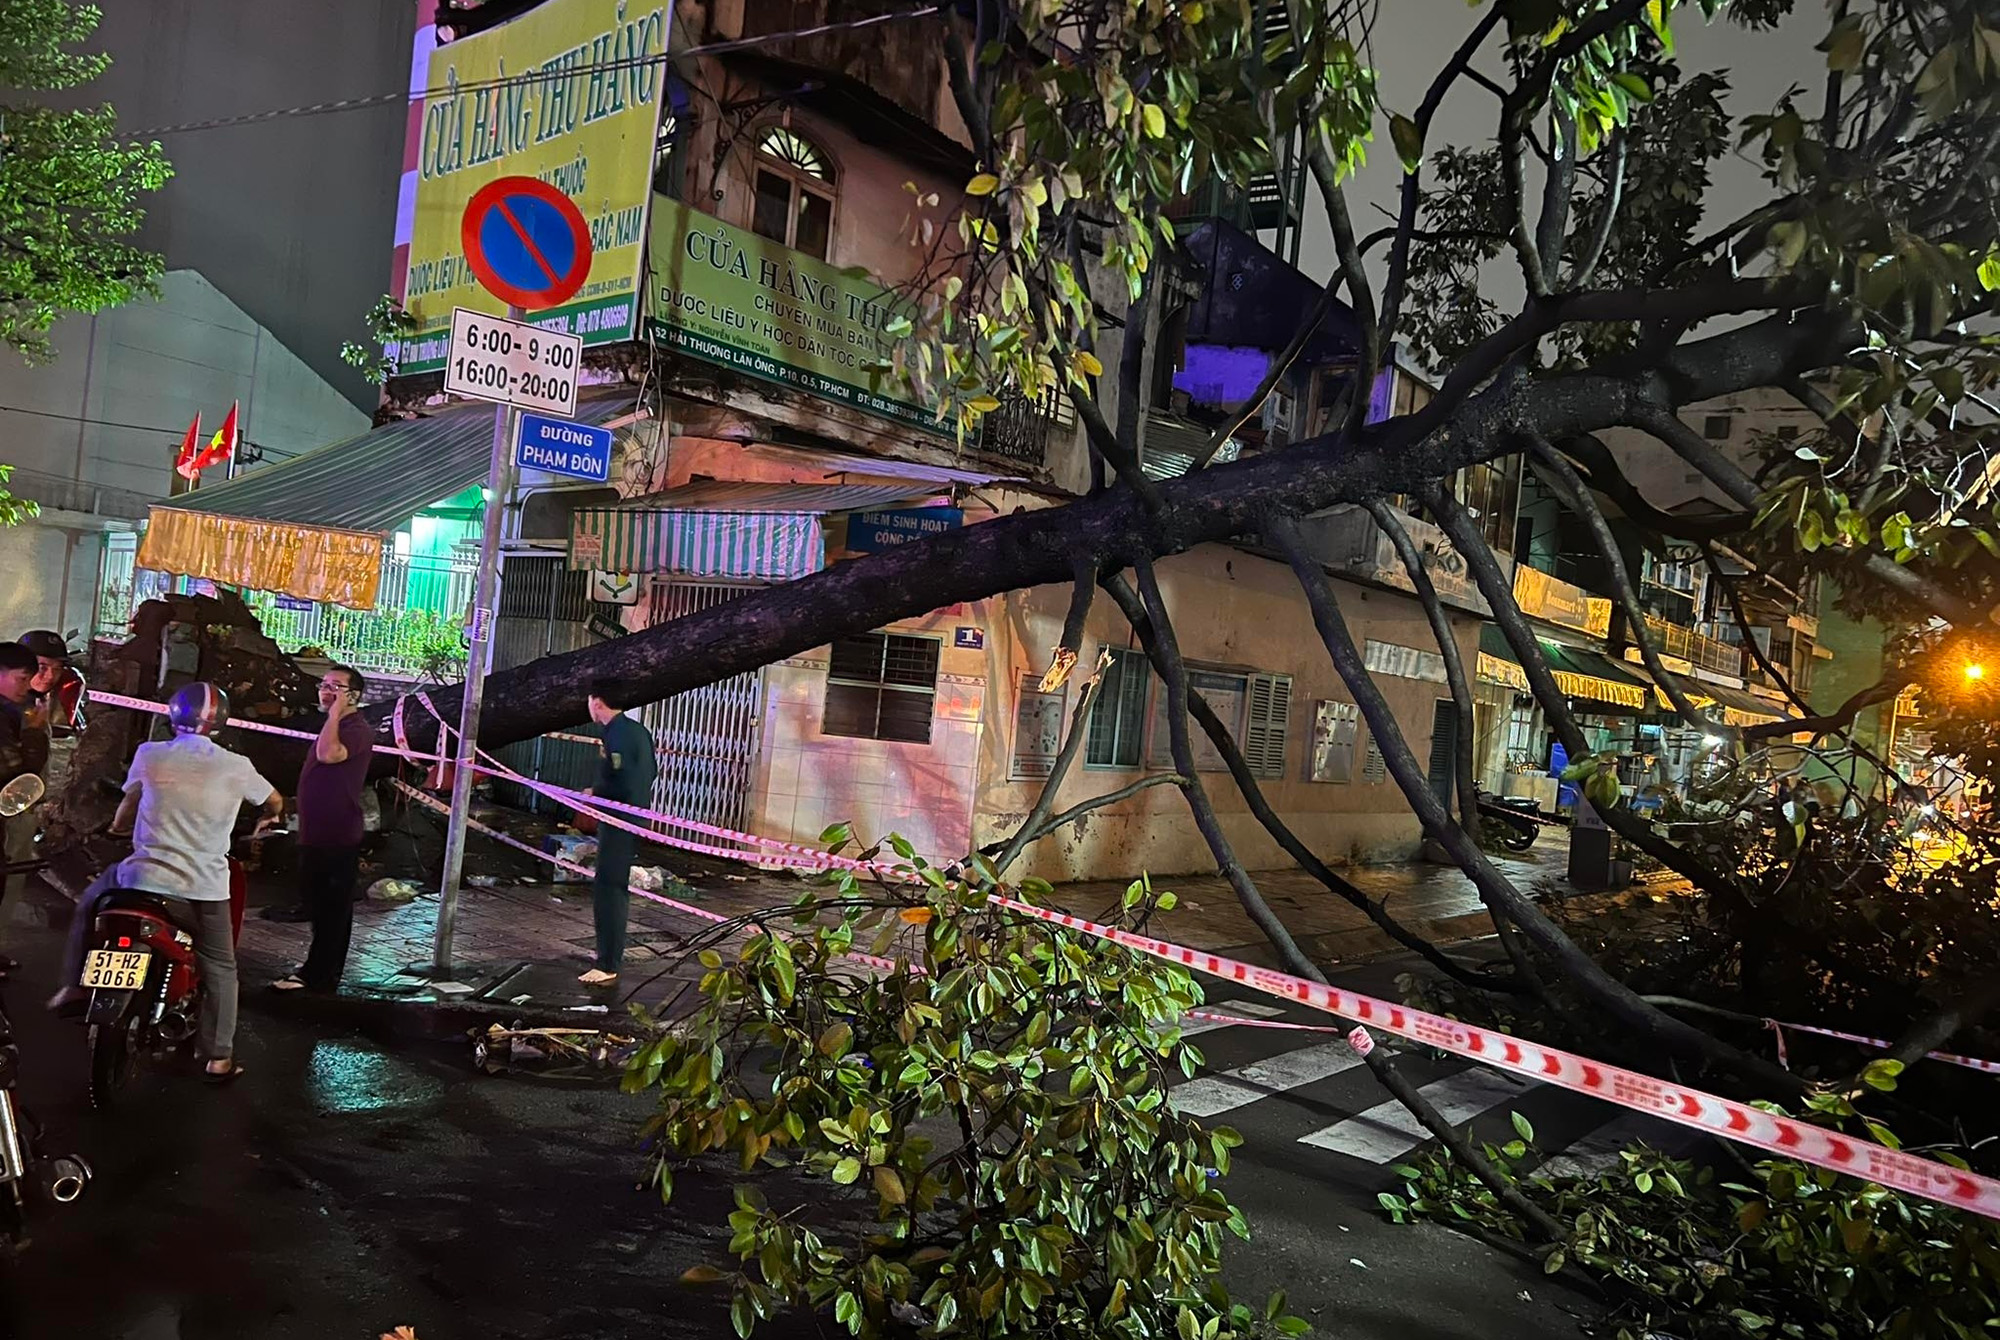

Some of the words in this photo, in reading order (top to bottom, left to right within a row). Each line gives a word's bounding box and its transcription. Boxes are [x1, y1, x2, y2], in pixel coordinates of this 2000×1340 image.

[423, 66, 465, 180] CỬA
[467, 56, 533, 166] HÀNG
[614, 205, 643, 247] NAM
[686, 225, 751, 281] CỬA
[758, 258, 838, 313] HÀNG
[661, 286, 706, 315] DƯỢC
[711, 304, 745, 330] LIỆU
[750, 318, 760, 333] Y
[763, 323, 793, 346] HỌC
[797, 334, 825, 359] DÂN
[754, 294, 812, 328] CHUYÊN
[816, 317, 844, 340] MUA
[655, 326, 667, 340] 52
[669, 329, 687, 346] HẢI
[689, 337, 731, 360] THƯỢNG
[819, 379, 850, 398] TP.HCM
[540, 424, 594, 447] ĐƯỜNG
[523, 445, 567, 469] PHẠM
[571, 452, 602, 476] ĐÔN
[892, 515, 917, 530] SINH
[961, 629, 978, 643] 1
[90, 969, 136, 987] 3066
[95, 952, 141, 970] 51-H2
